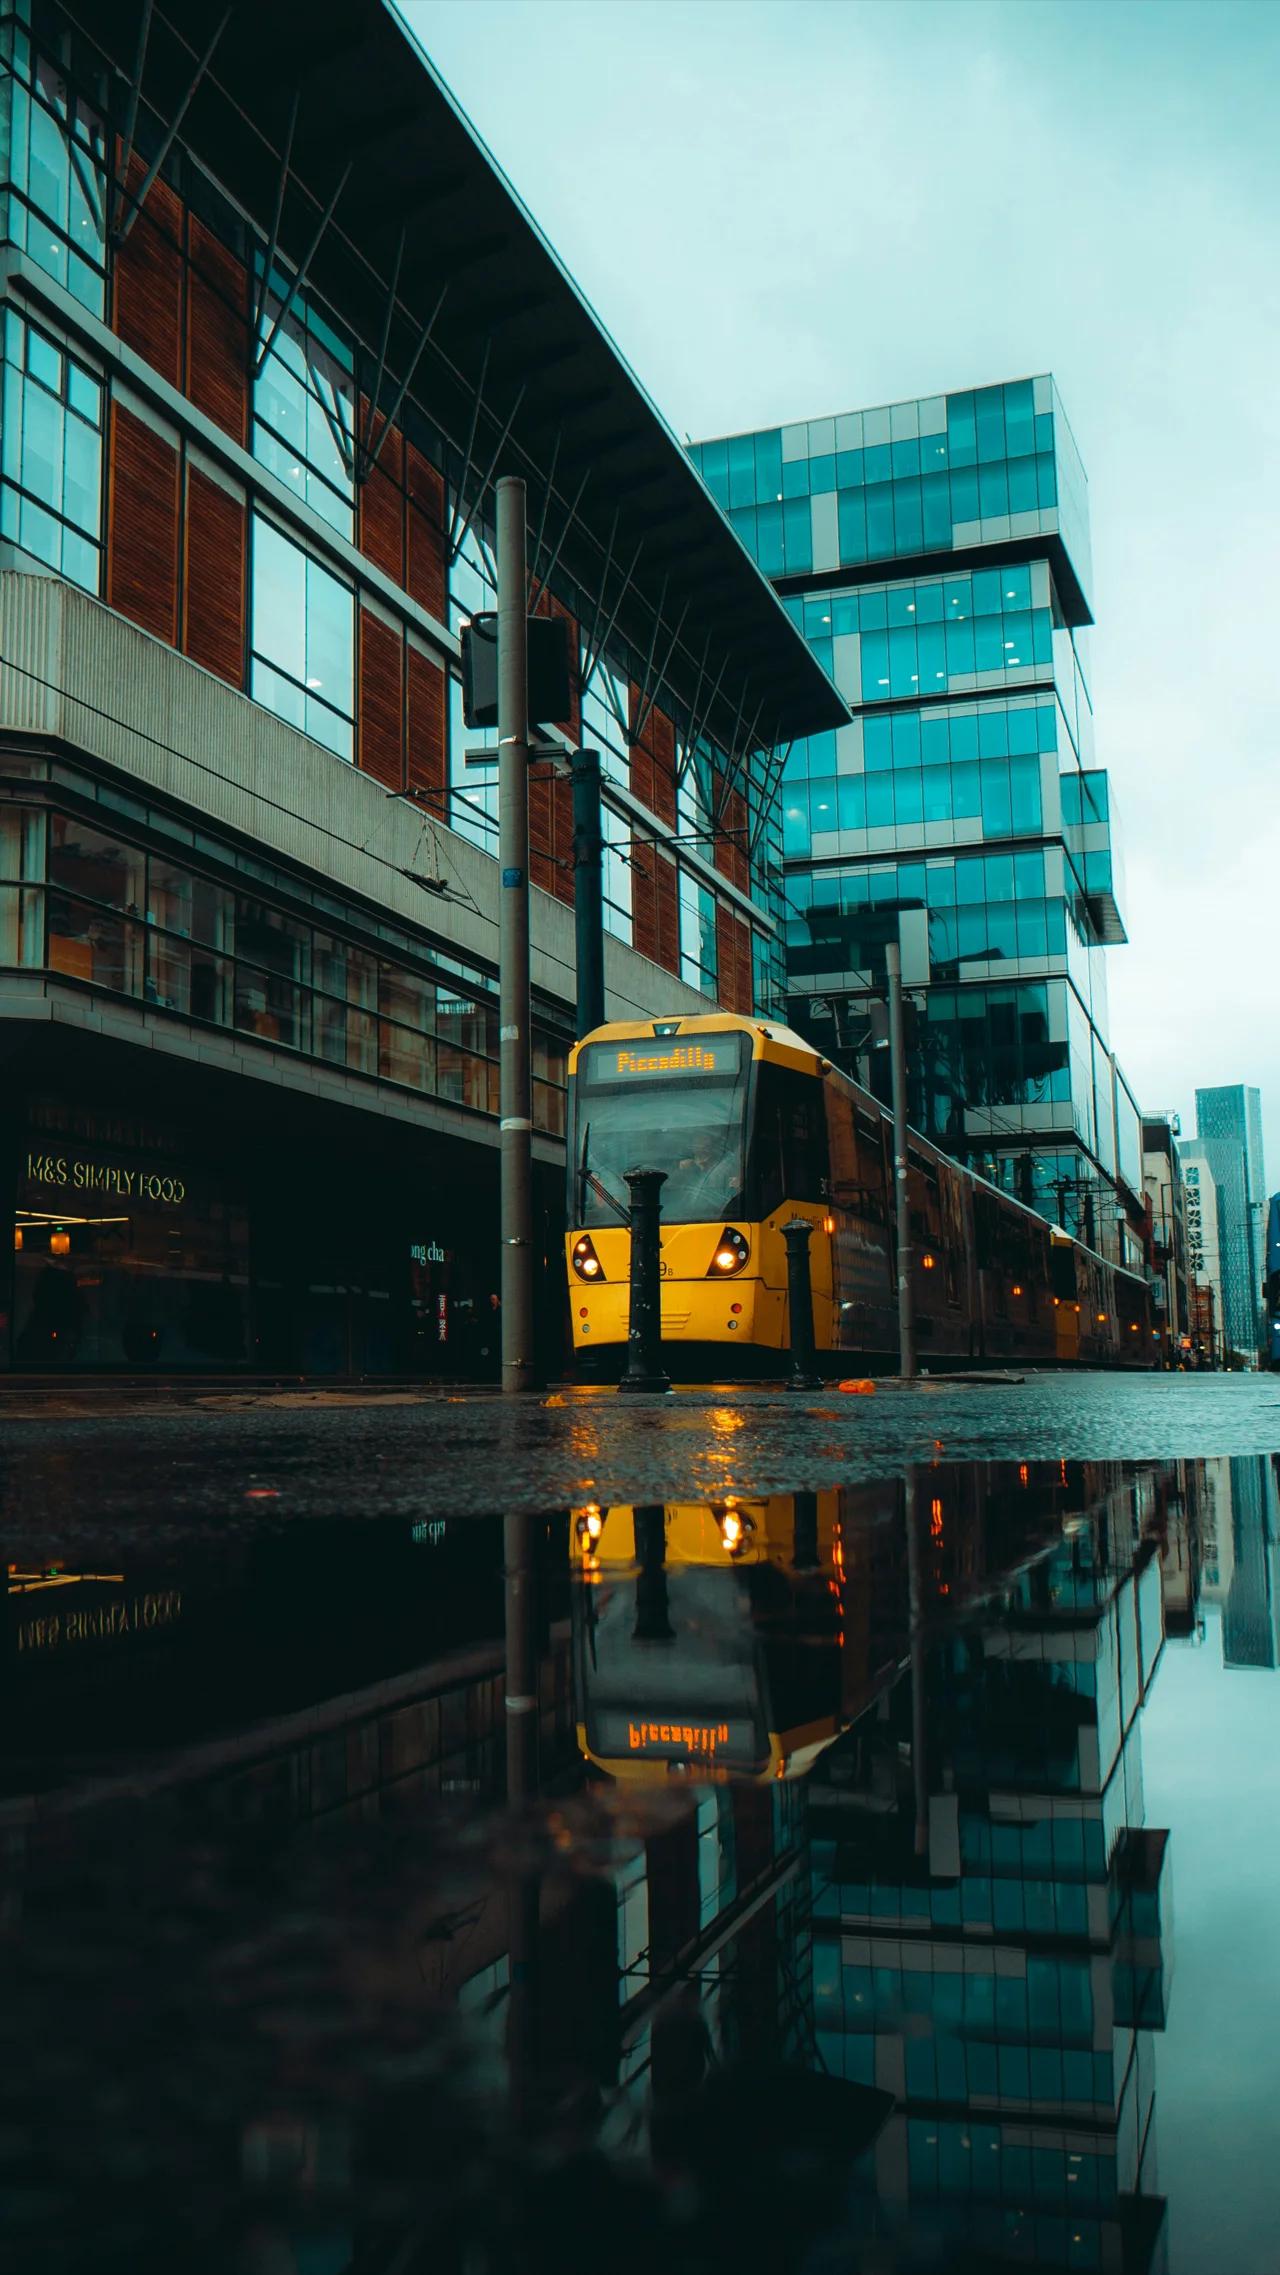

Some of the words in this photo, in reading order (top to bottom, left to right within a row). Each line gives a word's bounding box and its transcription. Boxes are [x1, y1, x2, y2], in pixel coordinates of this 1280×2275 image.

[617, 1047, 715, 1073] Piccadilly
[27, 1153, 68, 1185] M&S
[73, 1161, 135, 1196] SIMPLY
[139, 1174, 185, 1203] FOOD
[427, 1240, 444, 1262] cha
